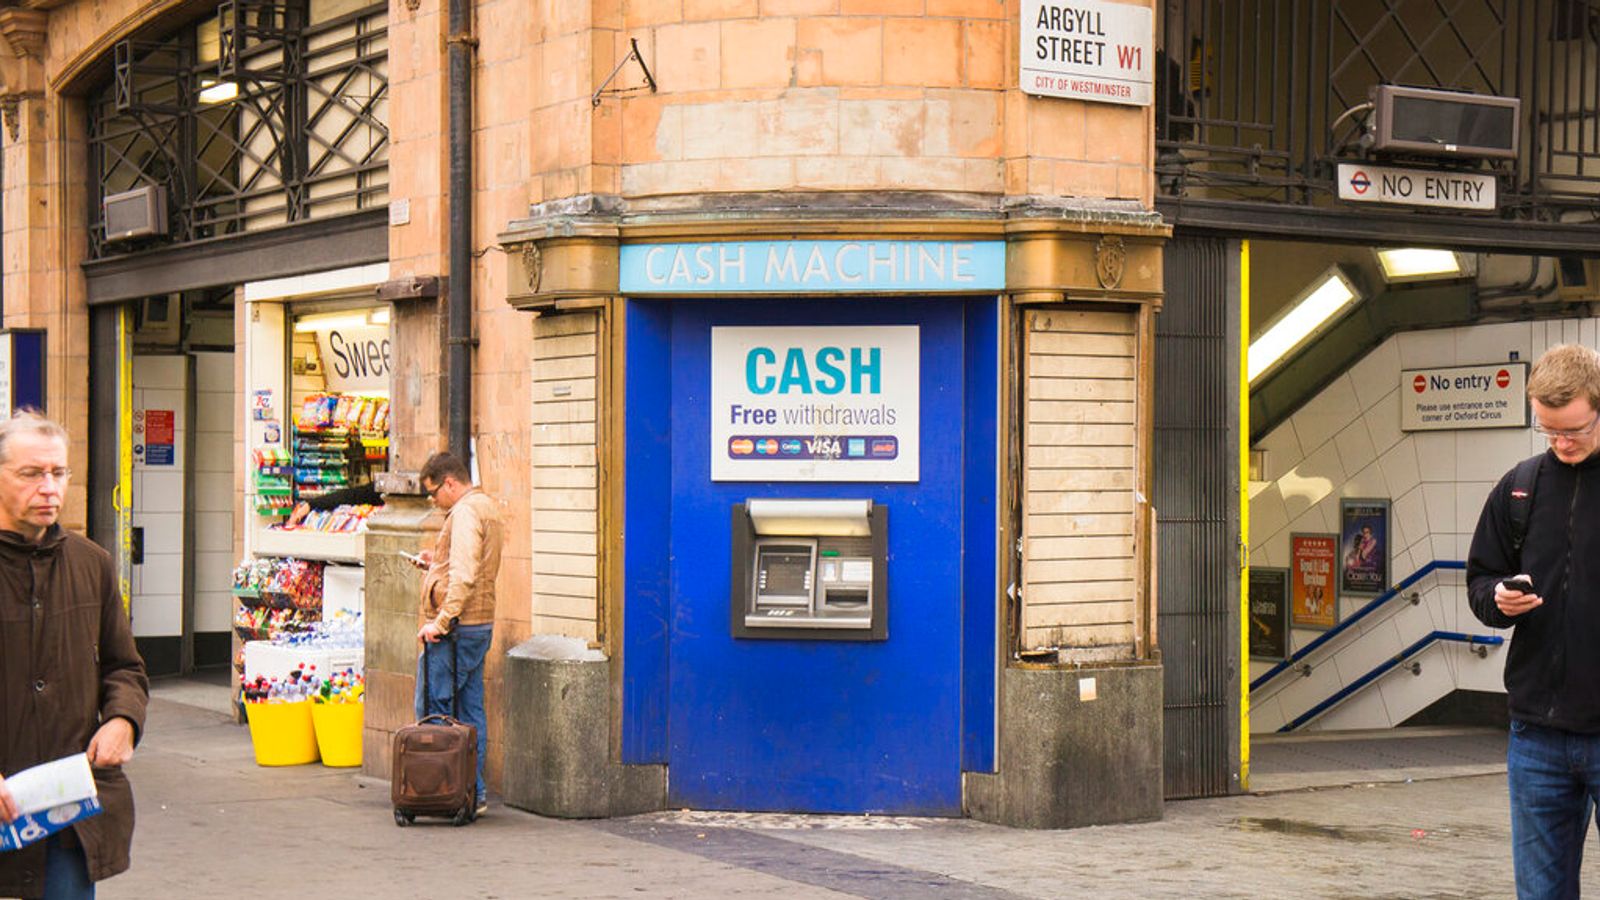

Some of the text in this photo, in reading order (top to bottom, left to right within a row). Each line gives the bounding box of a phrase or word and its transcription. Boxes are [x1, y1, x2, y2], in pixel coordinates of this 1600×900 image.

[1037, 4, 1106, 36] ARGYLL
[1036, 35, 1142, 71] STREET W1
[1035, 76, 1132, 98] CITY OF WESTMINSTER
[1383, 174, 1484, 203] NO ENTRY
[645, 242, 976, 285] CASH MACHINE
[745, 346, 881, 395] CASH
[1430, 374, 1492, 391] No entry
[730, 404, 897, 425] Free withdrawals
[1416, 400, 1508, 412] Please use entrance on the
[1422, 410, 1502, 422] corner of Oxford Circus
[804, 440, 842, 454] VISA
